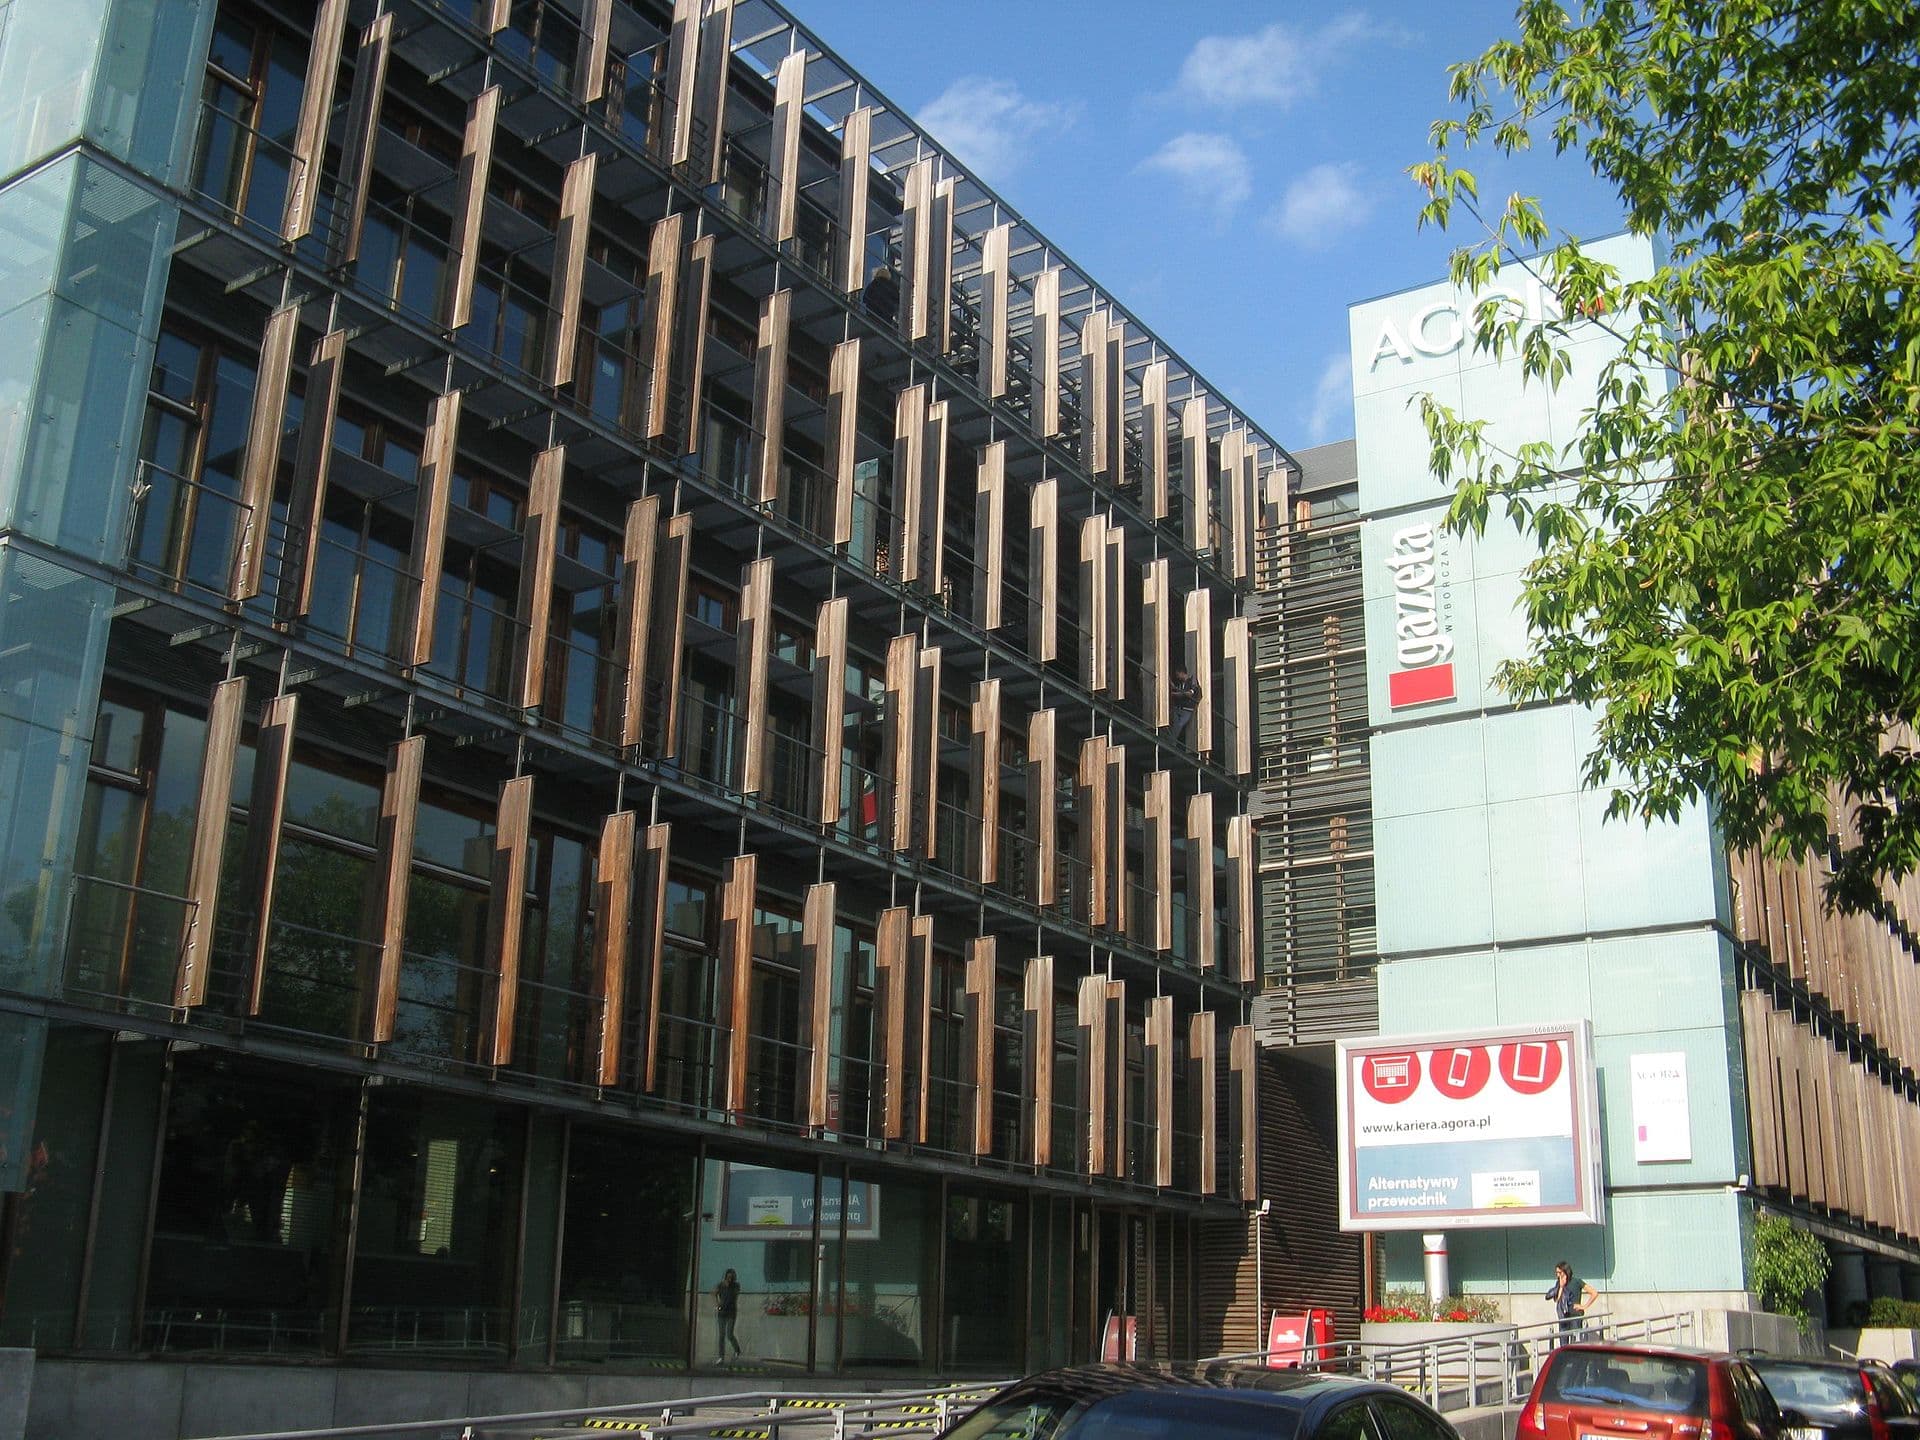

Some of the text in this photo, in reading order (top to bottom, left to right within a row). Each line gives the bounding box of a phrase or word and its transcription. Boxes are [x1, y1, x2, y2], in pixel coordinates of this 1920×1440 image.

[1369, 262, 1614, 374] AGOR
[1384, 520, 1454, 667] gazeta
[1439, 522, 1453, 633] WYBORCZA.P
[1362, 1115, 1491, 1133] www.kariera.agora.pl
[1367, 1191, 1448, 1211] przewodnik
[1368, 1176, 1458, 1191] Alternatywny
